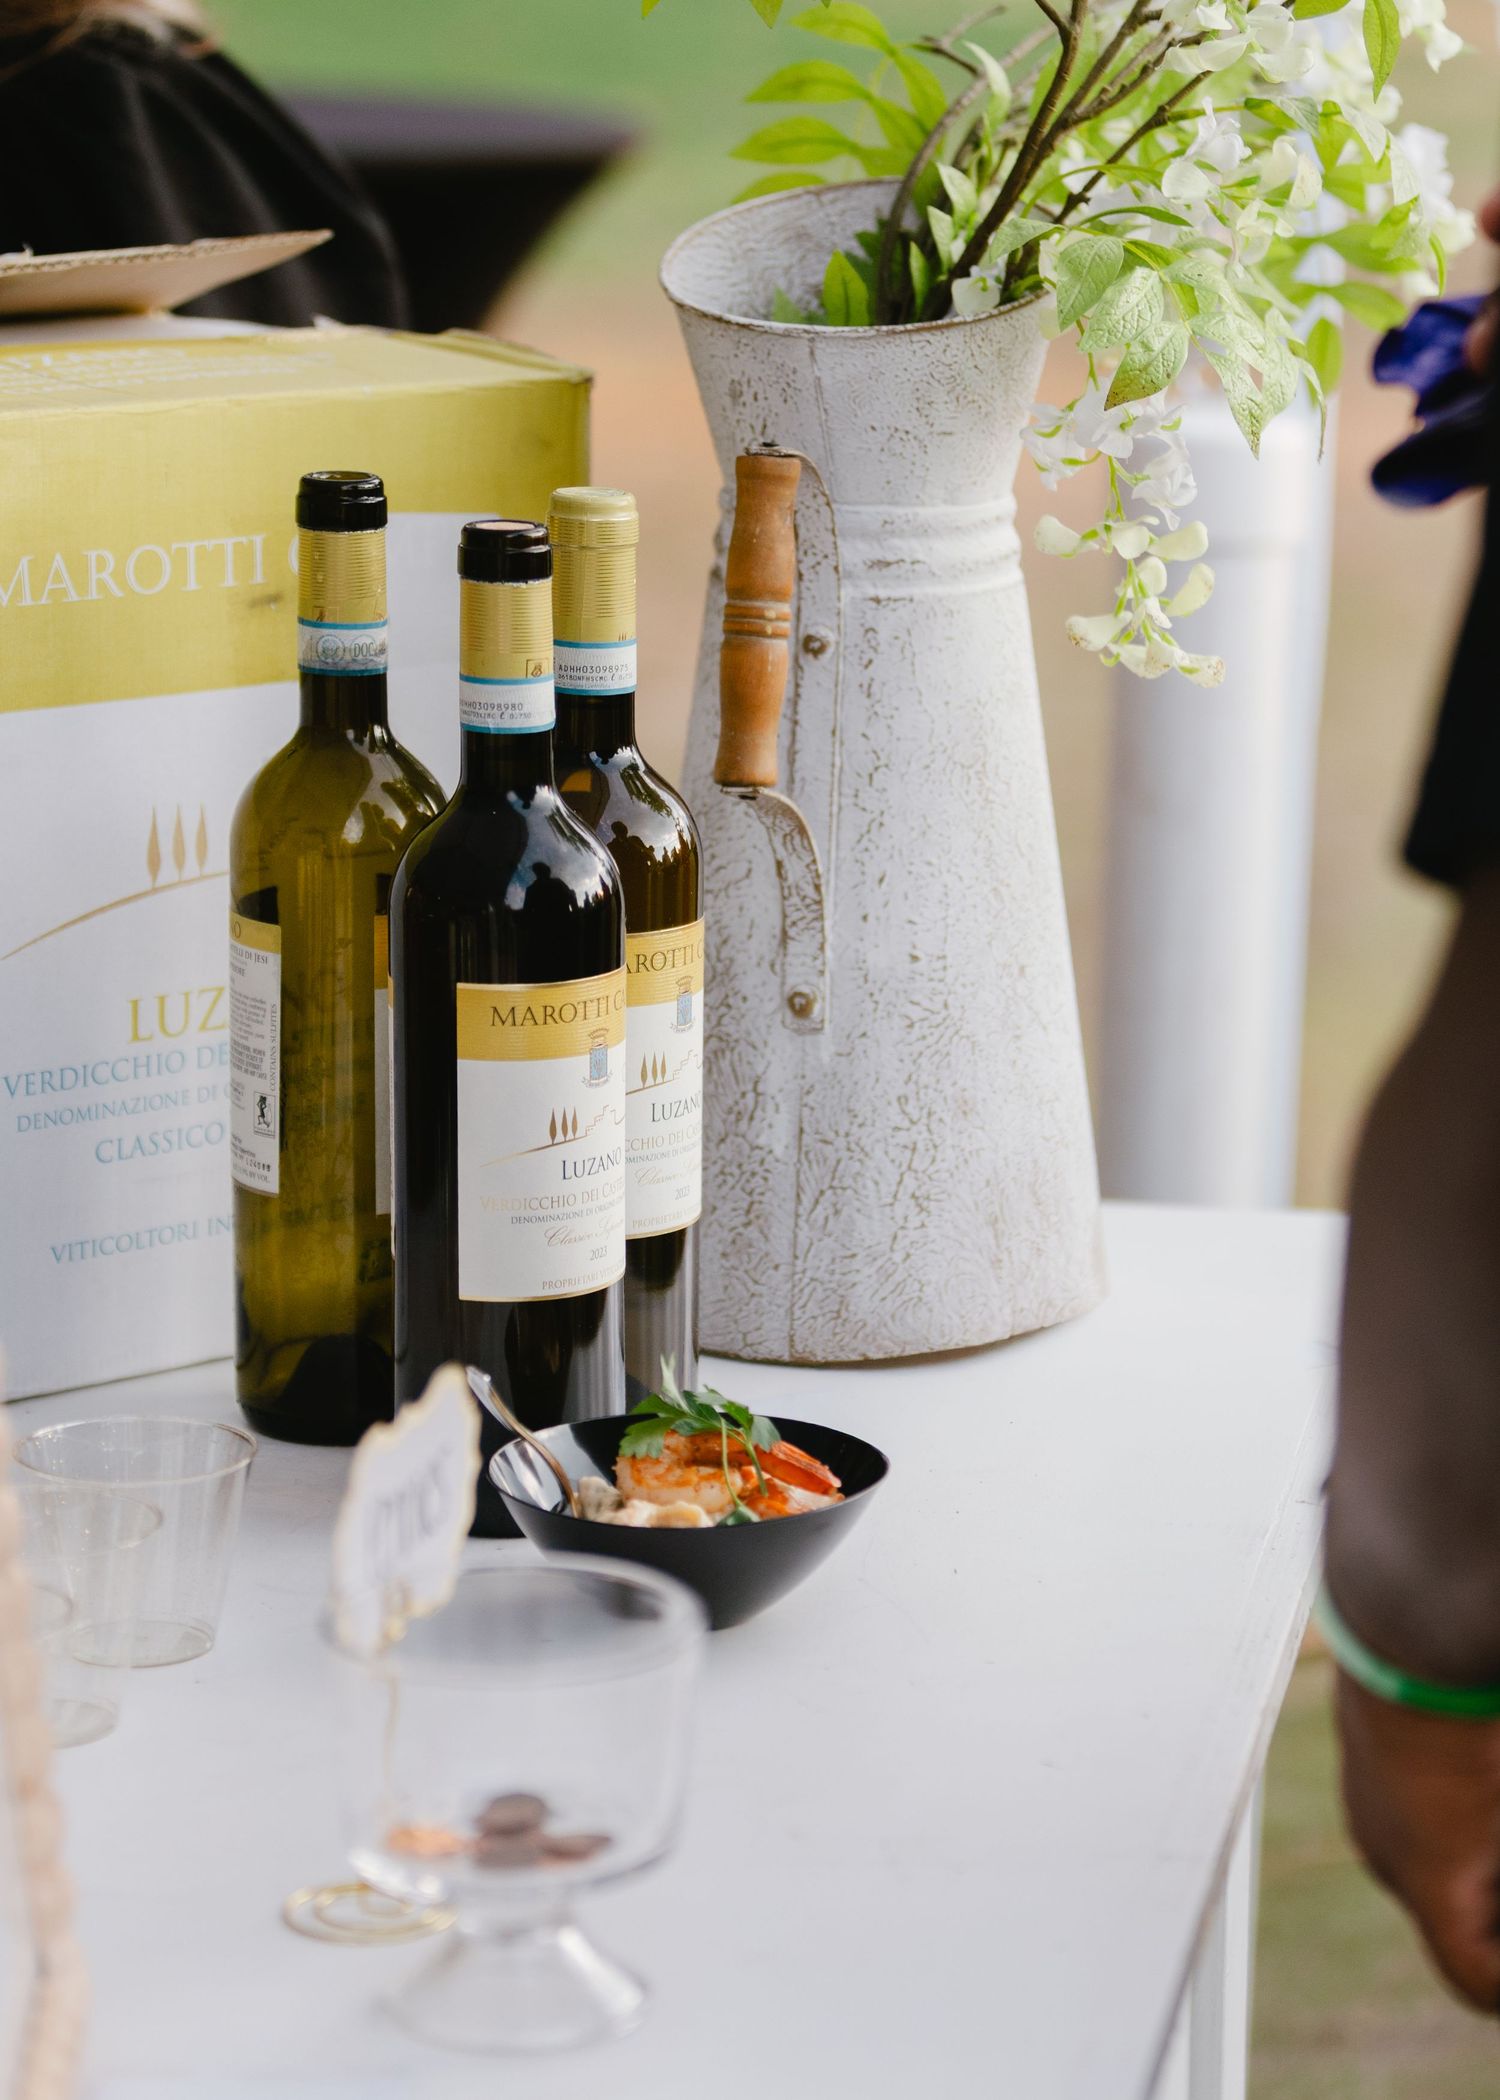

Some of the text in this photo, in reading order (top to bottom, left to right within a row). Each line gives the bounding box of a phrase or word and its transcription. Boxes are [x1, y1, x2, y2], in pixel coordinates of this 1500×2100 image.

[127, 985, 230, 1044] LUZ
[490, 995, 610, 1028] MAROTTI
[2, 1049, 187, 1101] VERDICCHIO
[16, 1088, 191, 1134] DENOMINAZIONE
[95, 1120, 226, 1164] CLASSICO
[668, 1129, 684, 1146] DEI
[481, 1193, 577, 1213] VERDICCHIO
[581, 1187, 600, 1205] DEI
[511, 1209, 584, 1225] DENOMINAZIONE
[585, 1207, 595, 1218] DI
[50, 1219, 199, 1264] VITICOLTORI
[589, 1245, 608, 1261] 2023
[542, 1272, 599, 1291] PROPRIETARI
